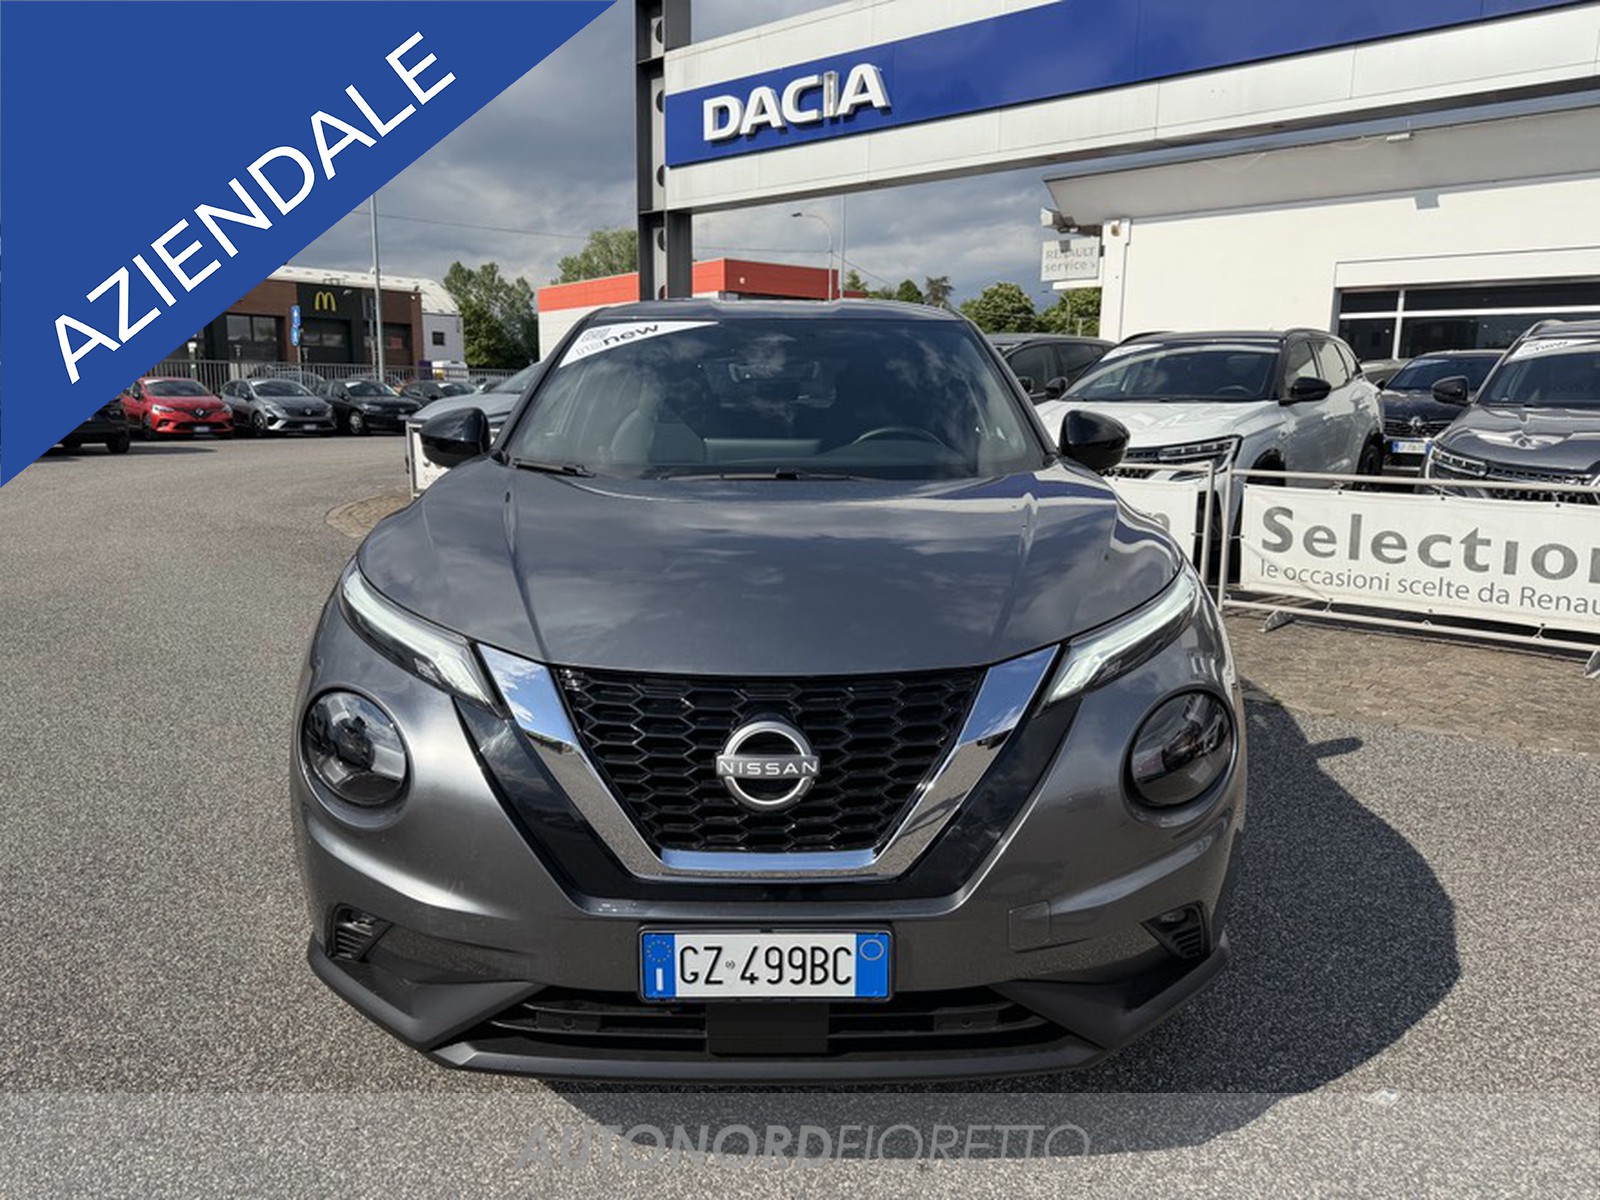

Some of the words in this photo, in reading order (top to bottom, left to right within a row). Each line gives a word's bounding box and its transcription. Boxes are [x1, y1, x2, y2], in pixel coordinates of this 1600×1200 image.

[703, 63, 891, 141] DACIA
[1046, 246, 1096, 260] REULT
[1260, 558, 1279, 577] le
[1283, 568, 1391, 592] occasioni
[1397, 576, 1470, 601] scelte
[1477, 581, 1510, 605] da
[718, 760, 818, 776] NISSAN
